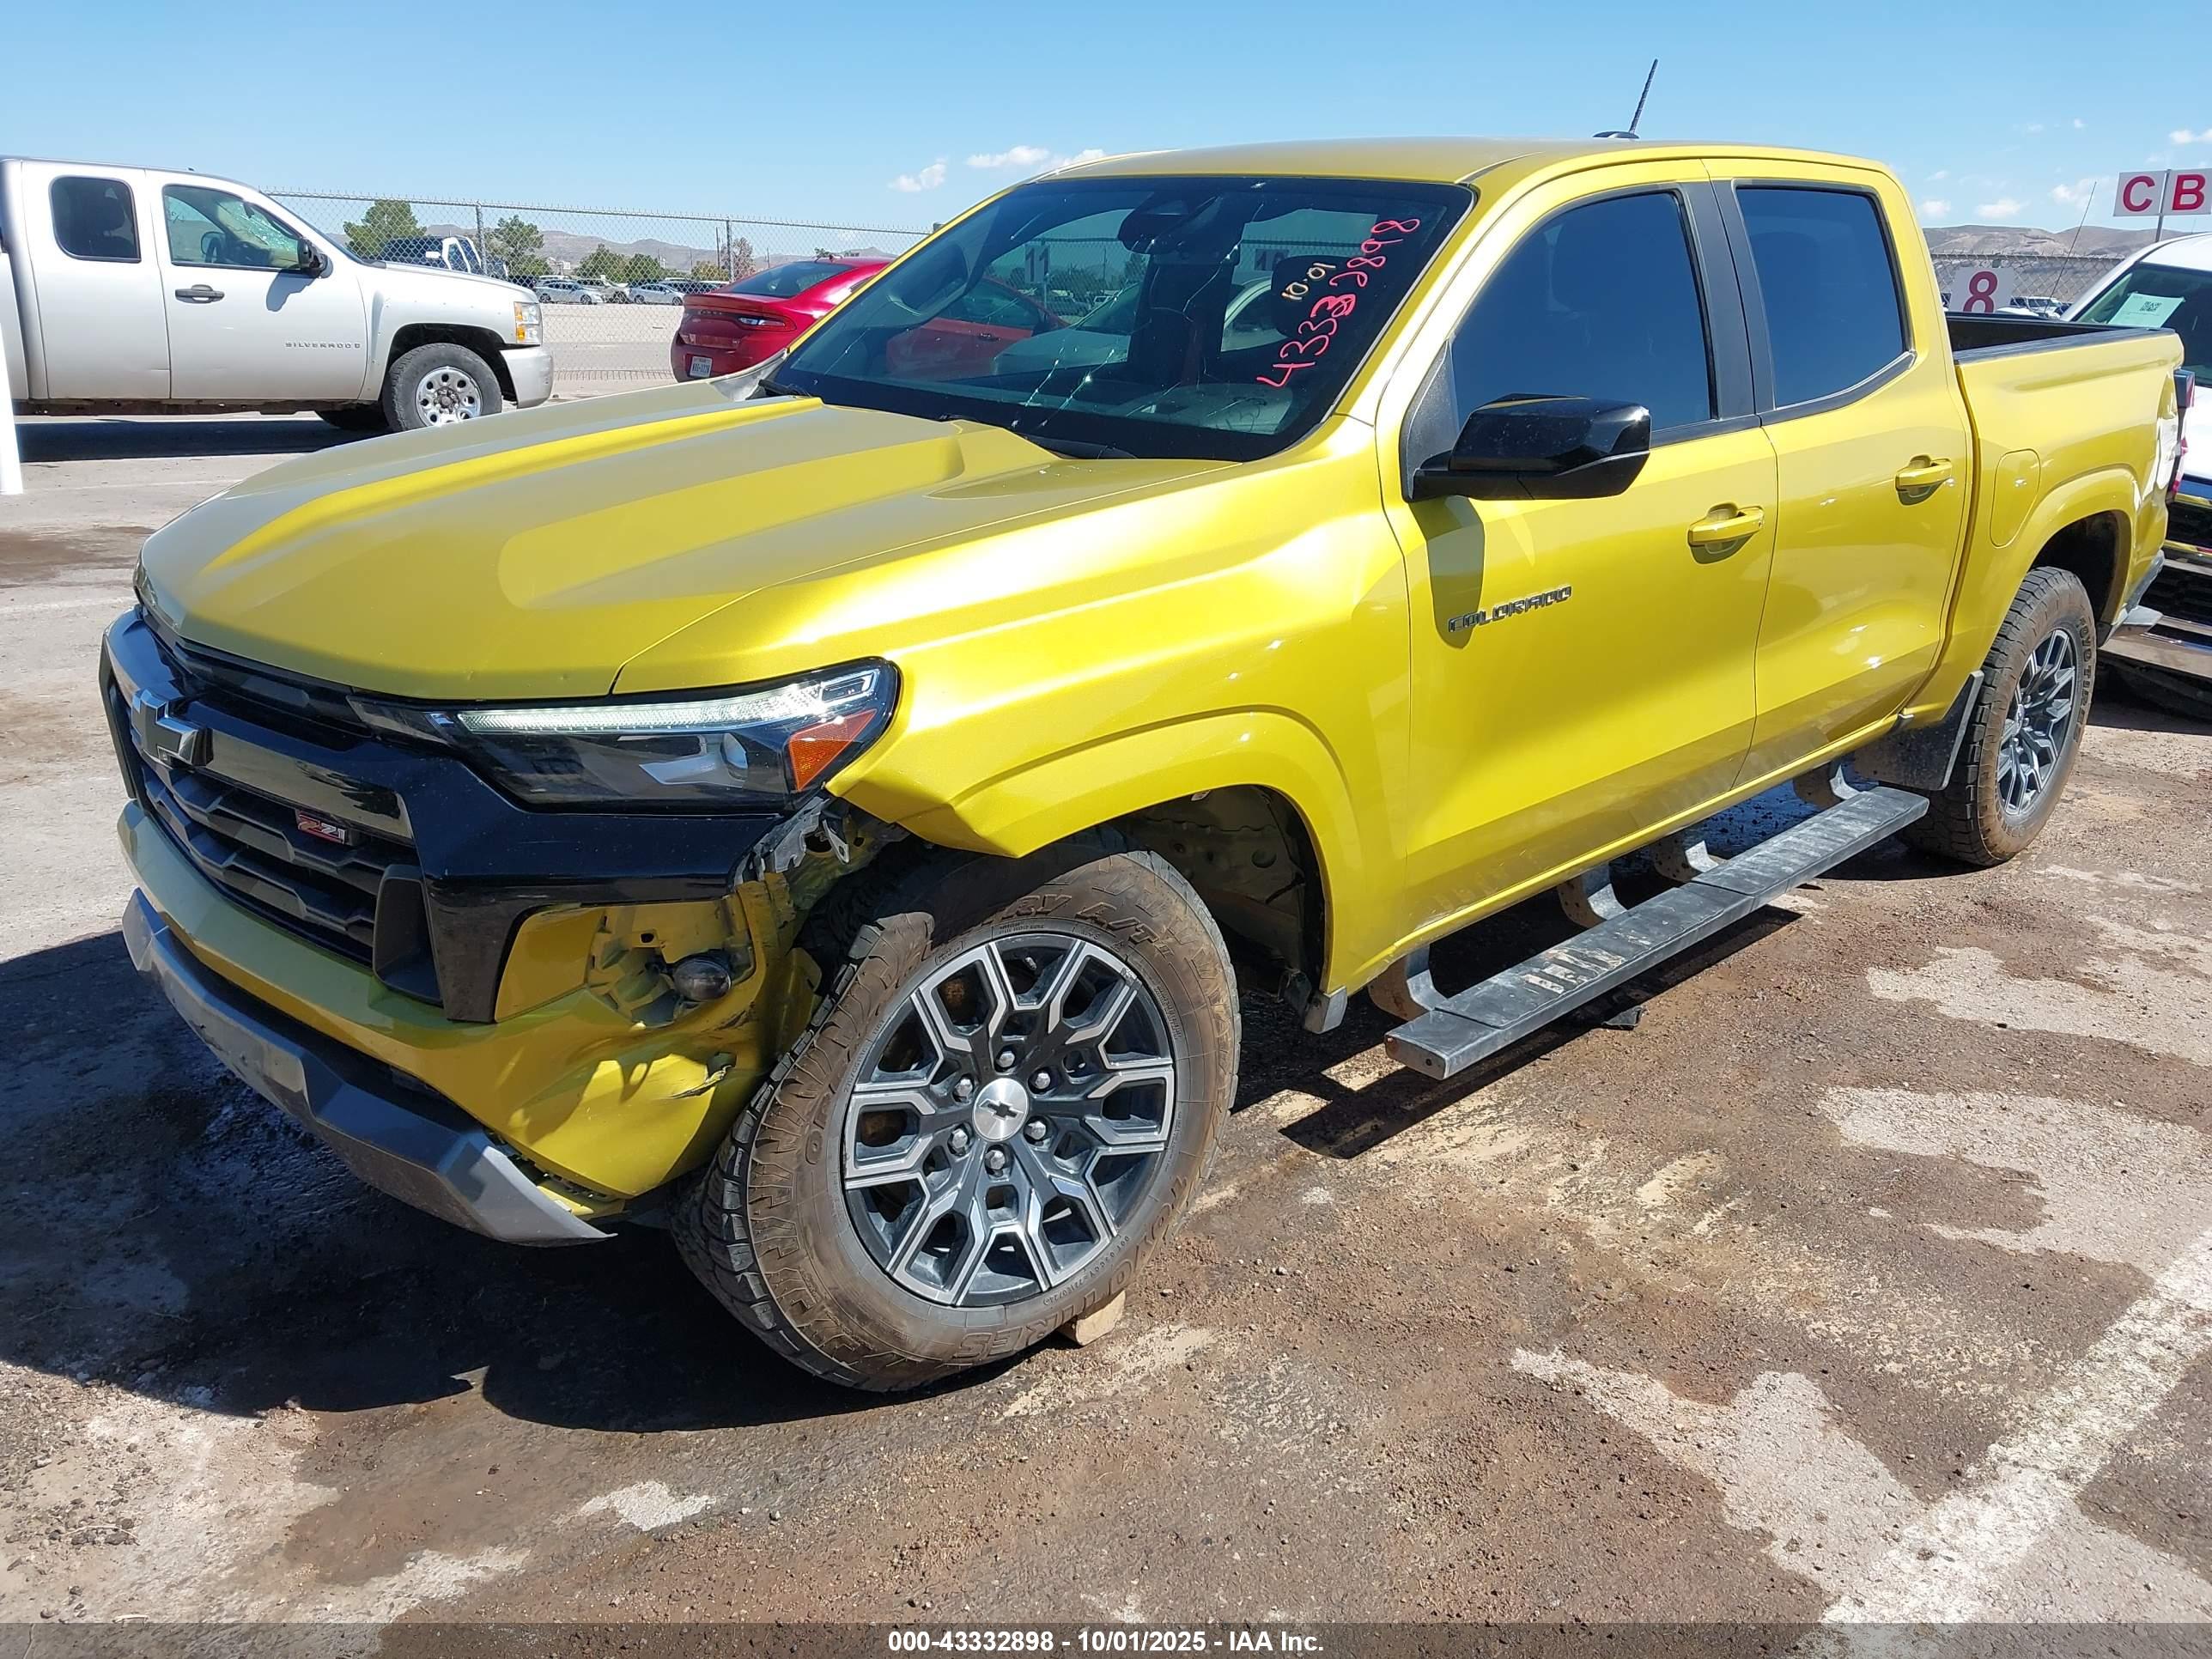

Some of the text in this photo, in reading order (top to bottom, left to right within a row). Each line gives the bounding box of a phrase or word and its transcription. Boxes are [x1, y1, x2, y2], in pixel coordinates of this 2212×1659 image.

[2122, 173, 2207, 212] C B
[1025, 246, 1048, 283] 11
[1962, 270, 1999, 313] 8
[1449, 586, 1571, 632] COLORADO
[298, 814, 345, 844] Z71
